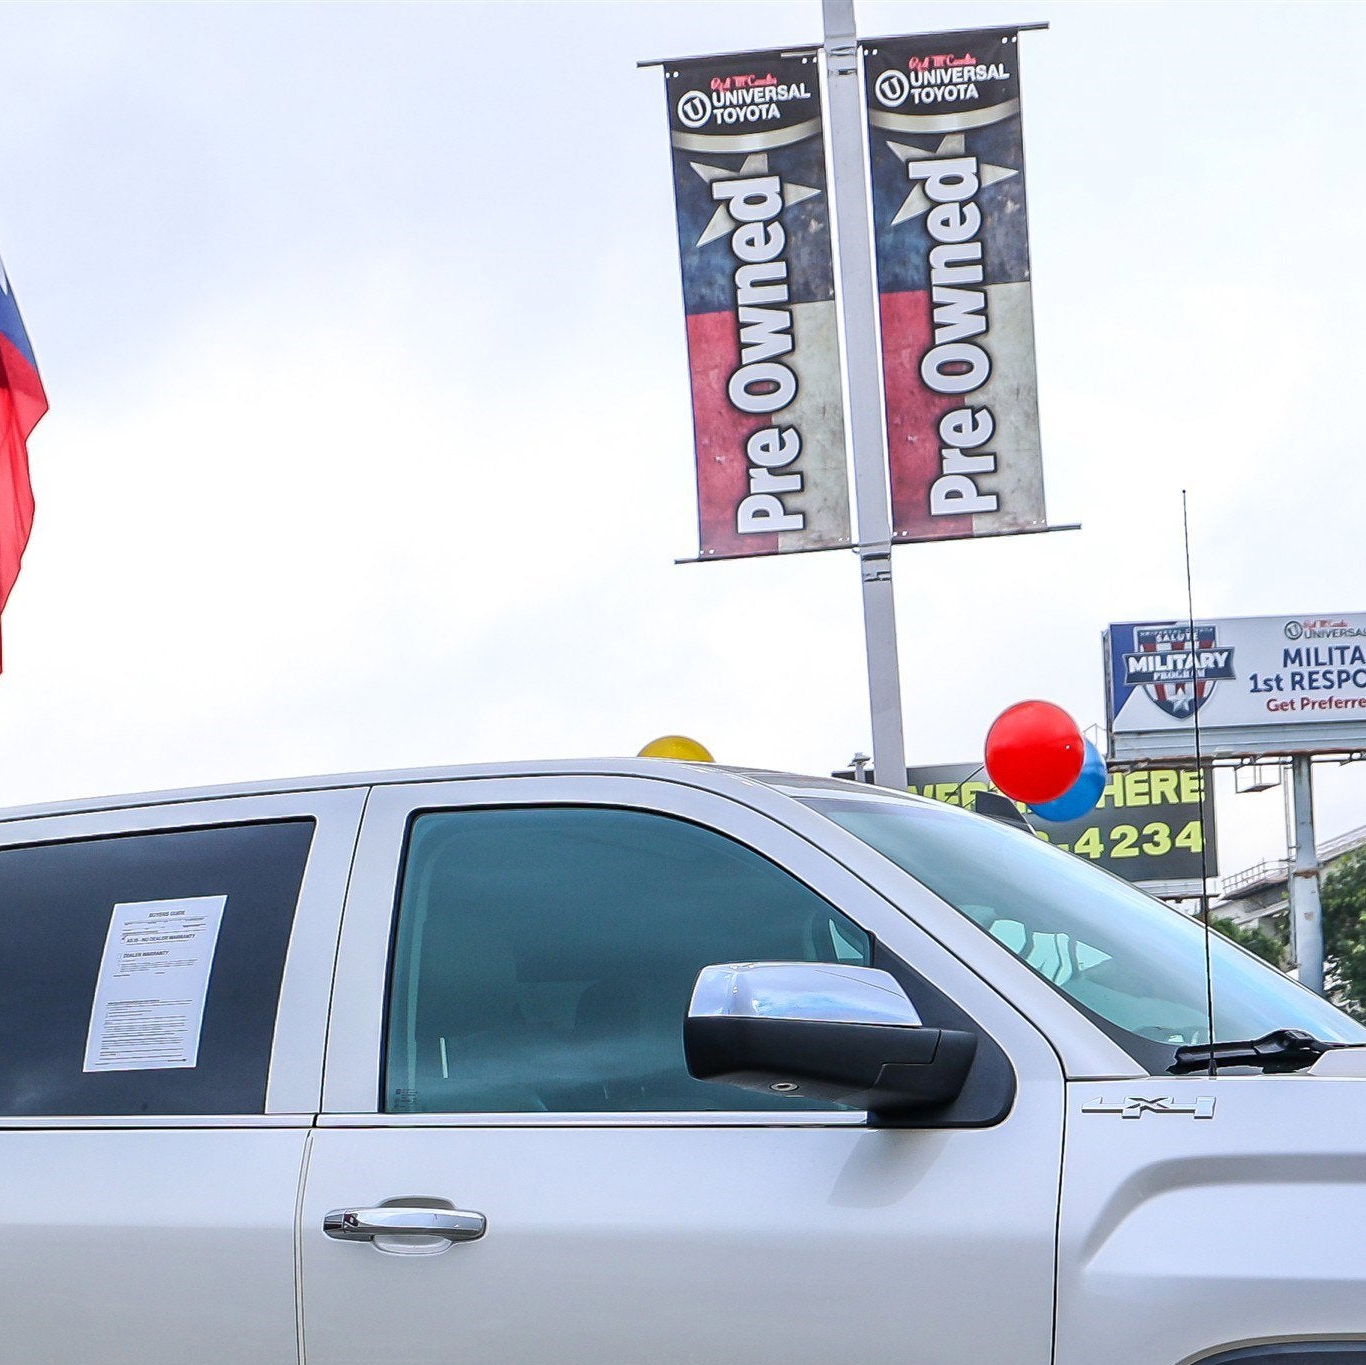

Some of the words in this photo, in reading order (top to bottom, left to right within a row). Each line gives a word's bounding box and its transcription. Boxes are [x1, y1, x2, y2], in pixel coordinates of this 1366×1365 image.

[910, 63, 1011, 87] UNIVERSAL
[712, 83, 811, 108] UNIVERSAL
[910, 83, 979, 105] TOYOTA
[712, 103, 781, 125] TOYOTA
[908, 156, 992, 394] Owned
[711, 174, 797, 413] Owned
[930, 407, 998, 516] Pre
[737, 426, 805, 534] Pre
[1128, 651, 1229, 673] MILITARY
[1249, 673, 1284, 693] 1st
[1266, 698, 1296, 712] Get
[1096, 768, 1206, 808] HERE
